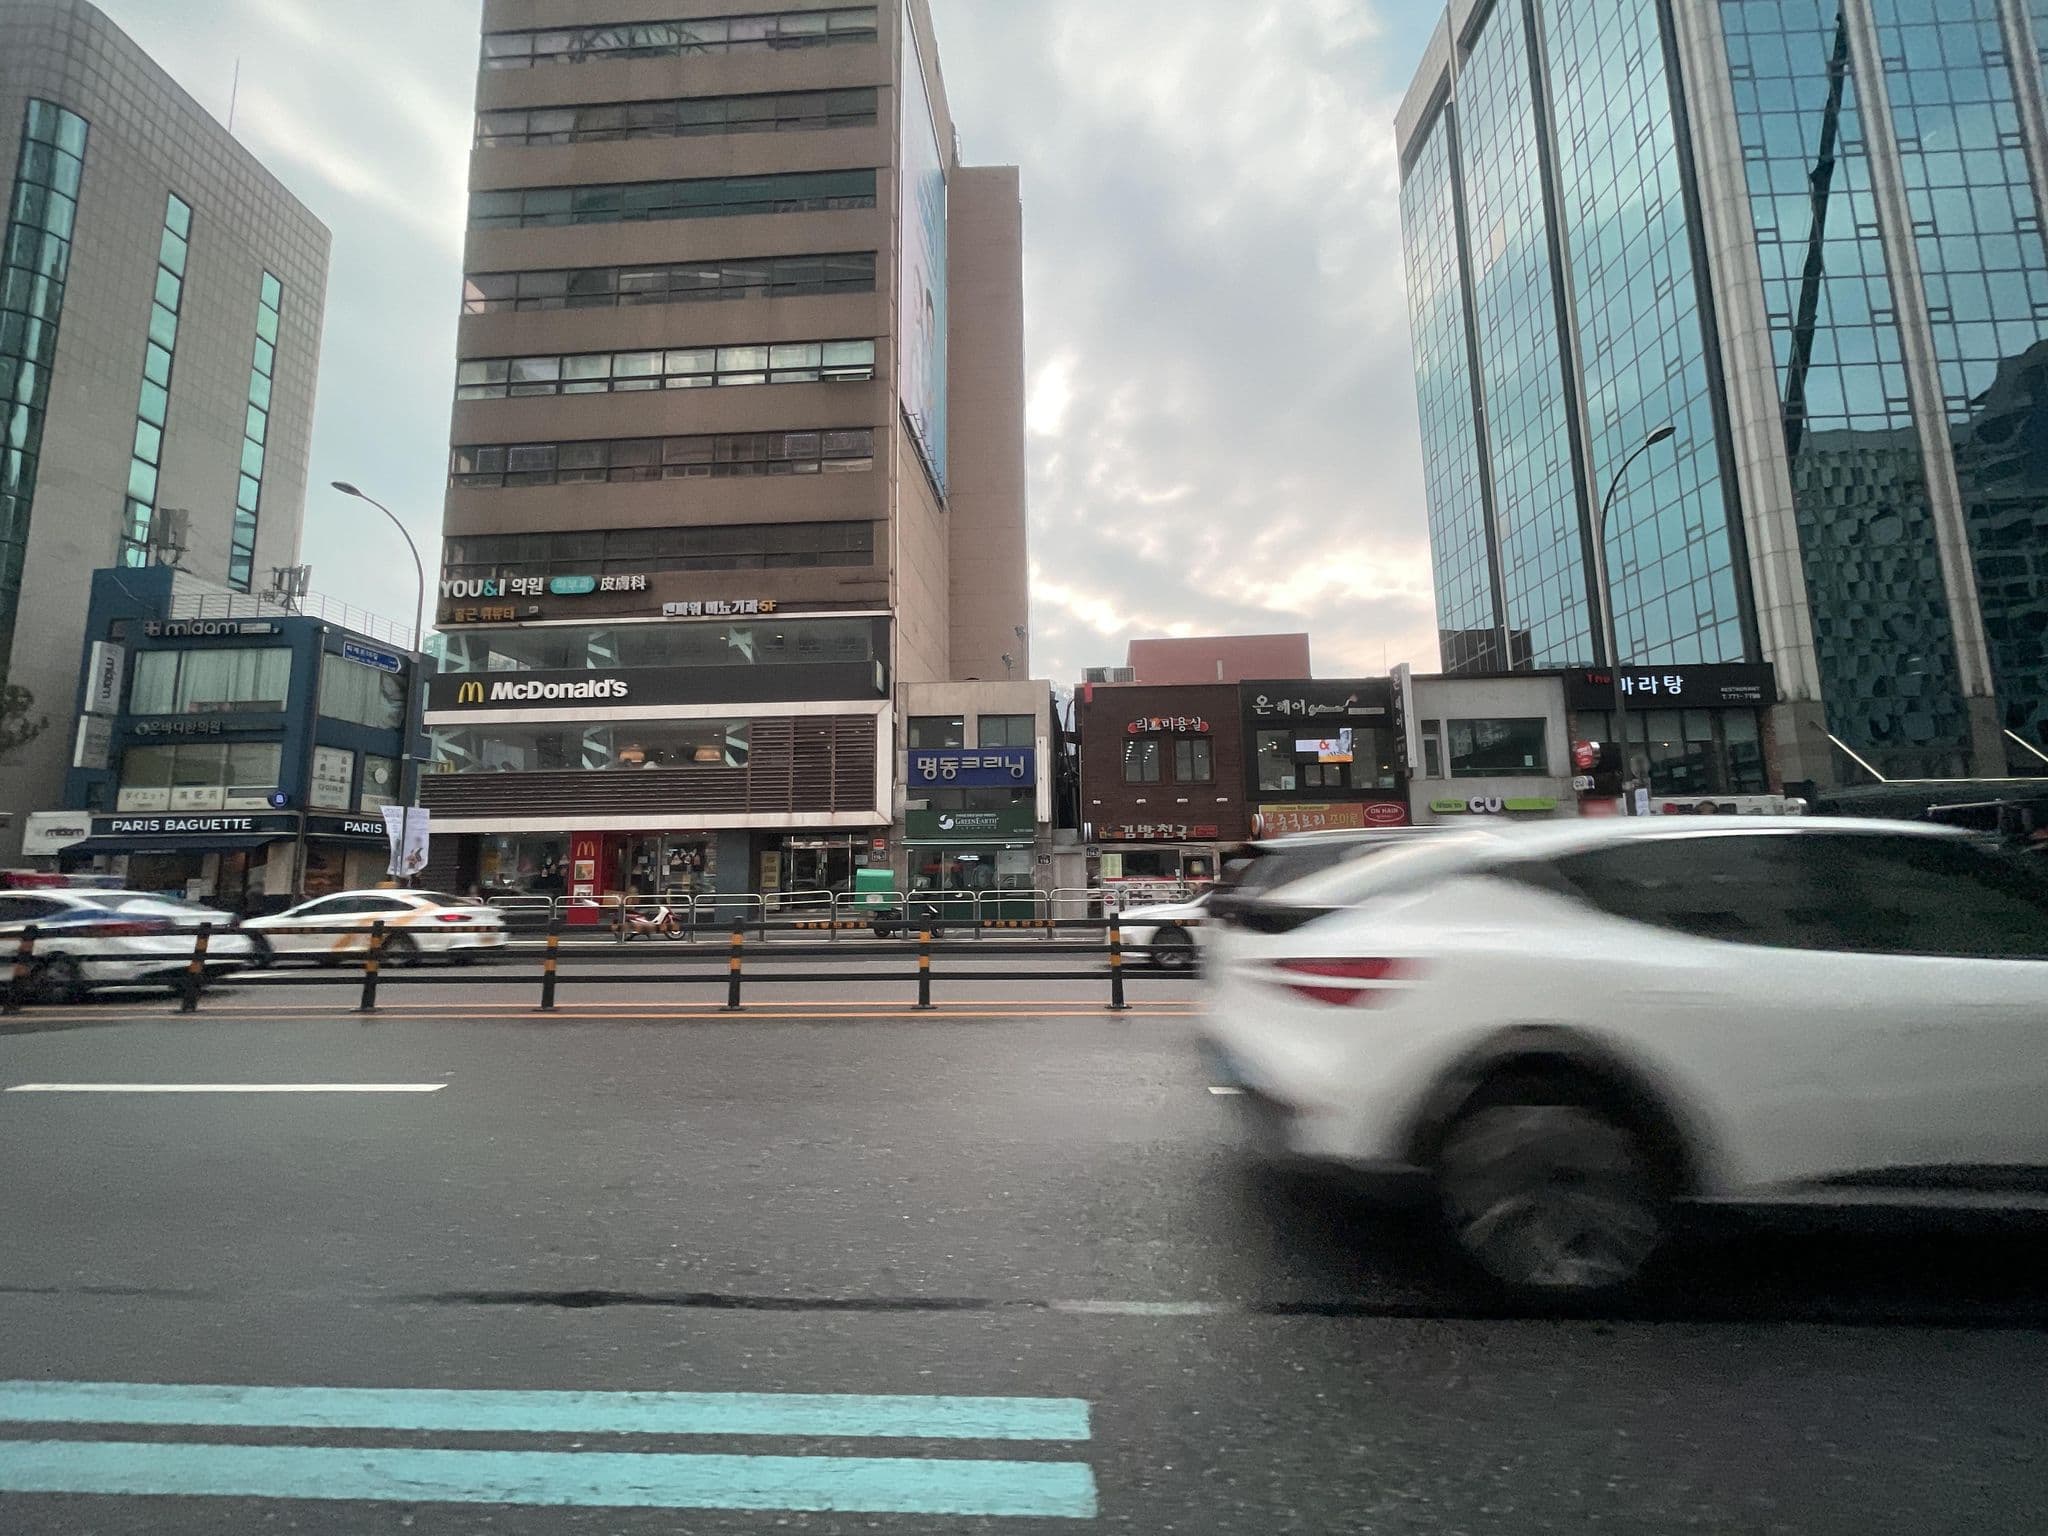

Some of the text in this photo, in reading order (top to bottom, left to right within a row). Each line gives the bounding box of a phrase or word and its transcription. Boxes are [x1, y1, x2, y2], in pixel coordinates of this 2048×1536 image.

[441, 578, 505, 598] YOU&I
[511, 577, 544, 595] 의원
[600, 574, 647, 592] 皮膚科
[705, 599, 758, 614] 비뇨기과
[759, 599, 777, 612] 5F
[165, 619, 238, 636] midam
[102, 656, 116, 699] midam
[490, 678, 629, 701] McDonald's
[917, 755, 1025, 781] 명동크리닝
[1469, 795, 1502, 813] CU
[111, 818, 252, 832] PARIS BAGUETTE
[344, 821, 383, 834] PARIS
